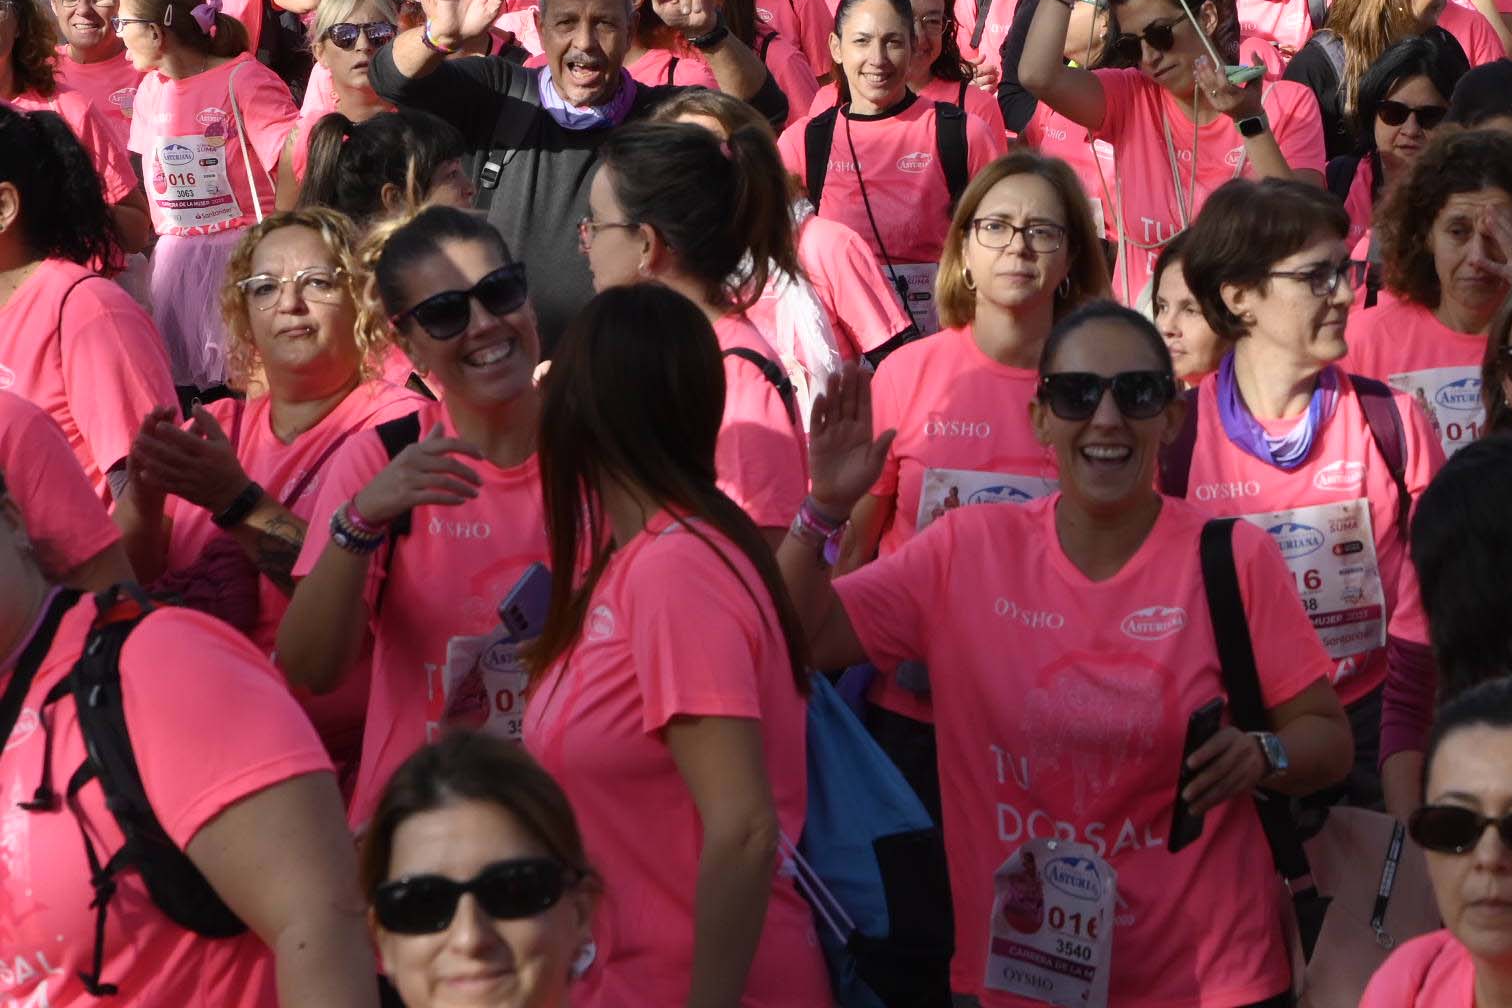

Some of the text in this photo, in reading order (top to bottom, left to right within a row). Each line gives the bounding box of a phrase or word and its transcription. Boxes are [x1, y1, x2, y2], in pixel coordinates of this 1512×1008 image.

[168, 172, 196, 186] 016
[177, 189, 195, 198] 3063
[1140, 216, 1174, 242] TU
[924, 420, 991, 439] OYSHO
[1446, 421, 1482, 441] 01
[1195, 479, 1262, 501] OYSHO
[994, 596, 1065, 630] OYSHO
[1055, 937, 1092, 962] 3540
